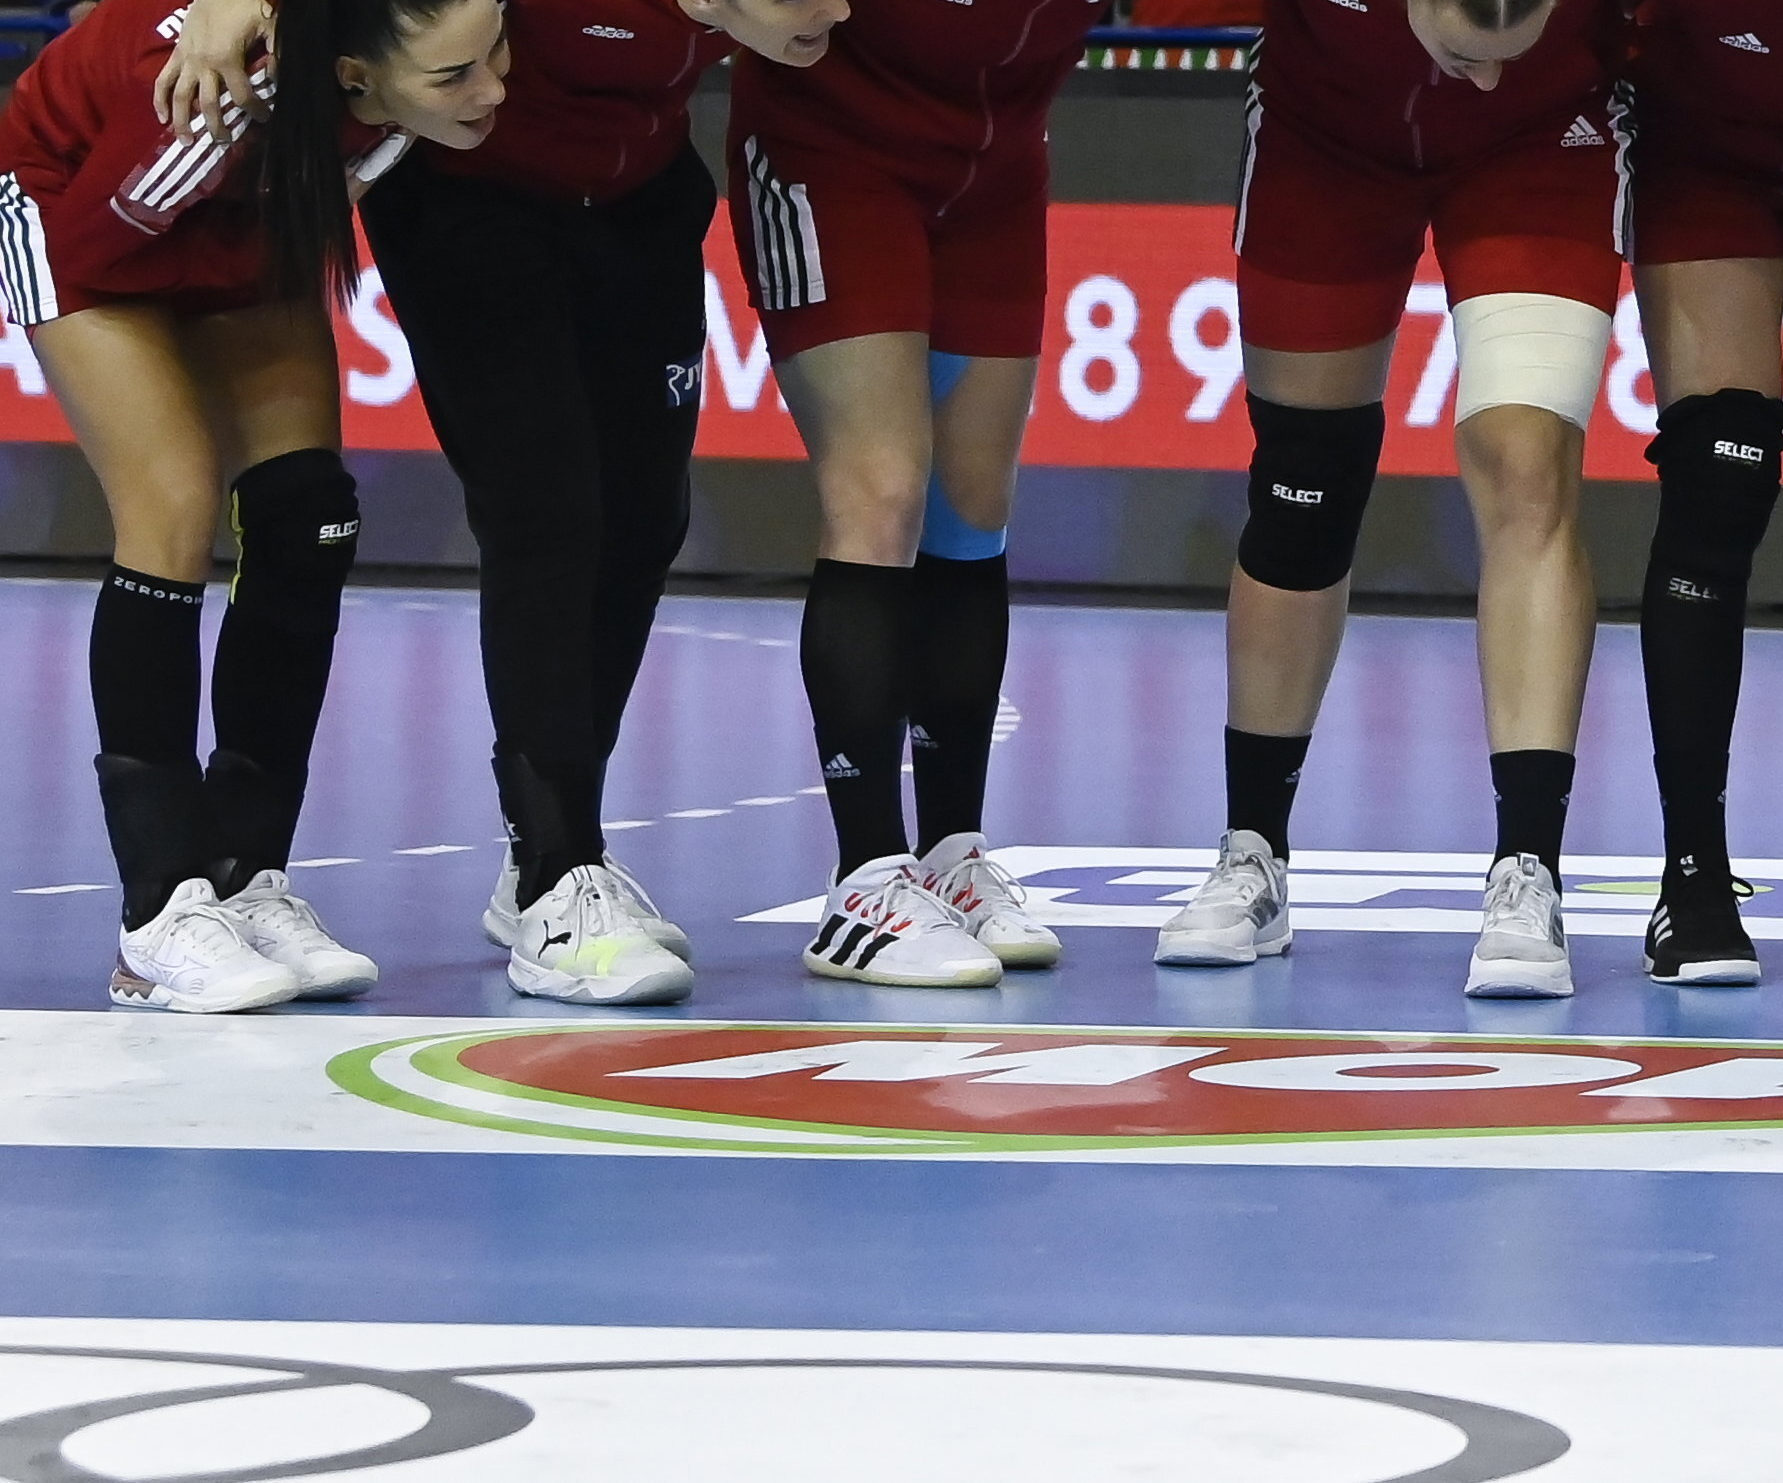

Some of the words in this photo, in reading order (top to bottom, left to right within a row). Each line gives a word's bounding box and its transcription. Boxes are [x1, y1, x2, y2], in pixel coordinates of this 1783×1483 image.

[583, 25, 635, 40] adidas
[1718, 34, 1771, 55] adidas
[1559, 133, 1605, 149] adidas
[1712, 438, 1764, 464] SELECT
[1270, 482, 1325, 506] SELECT
